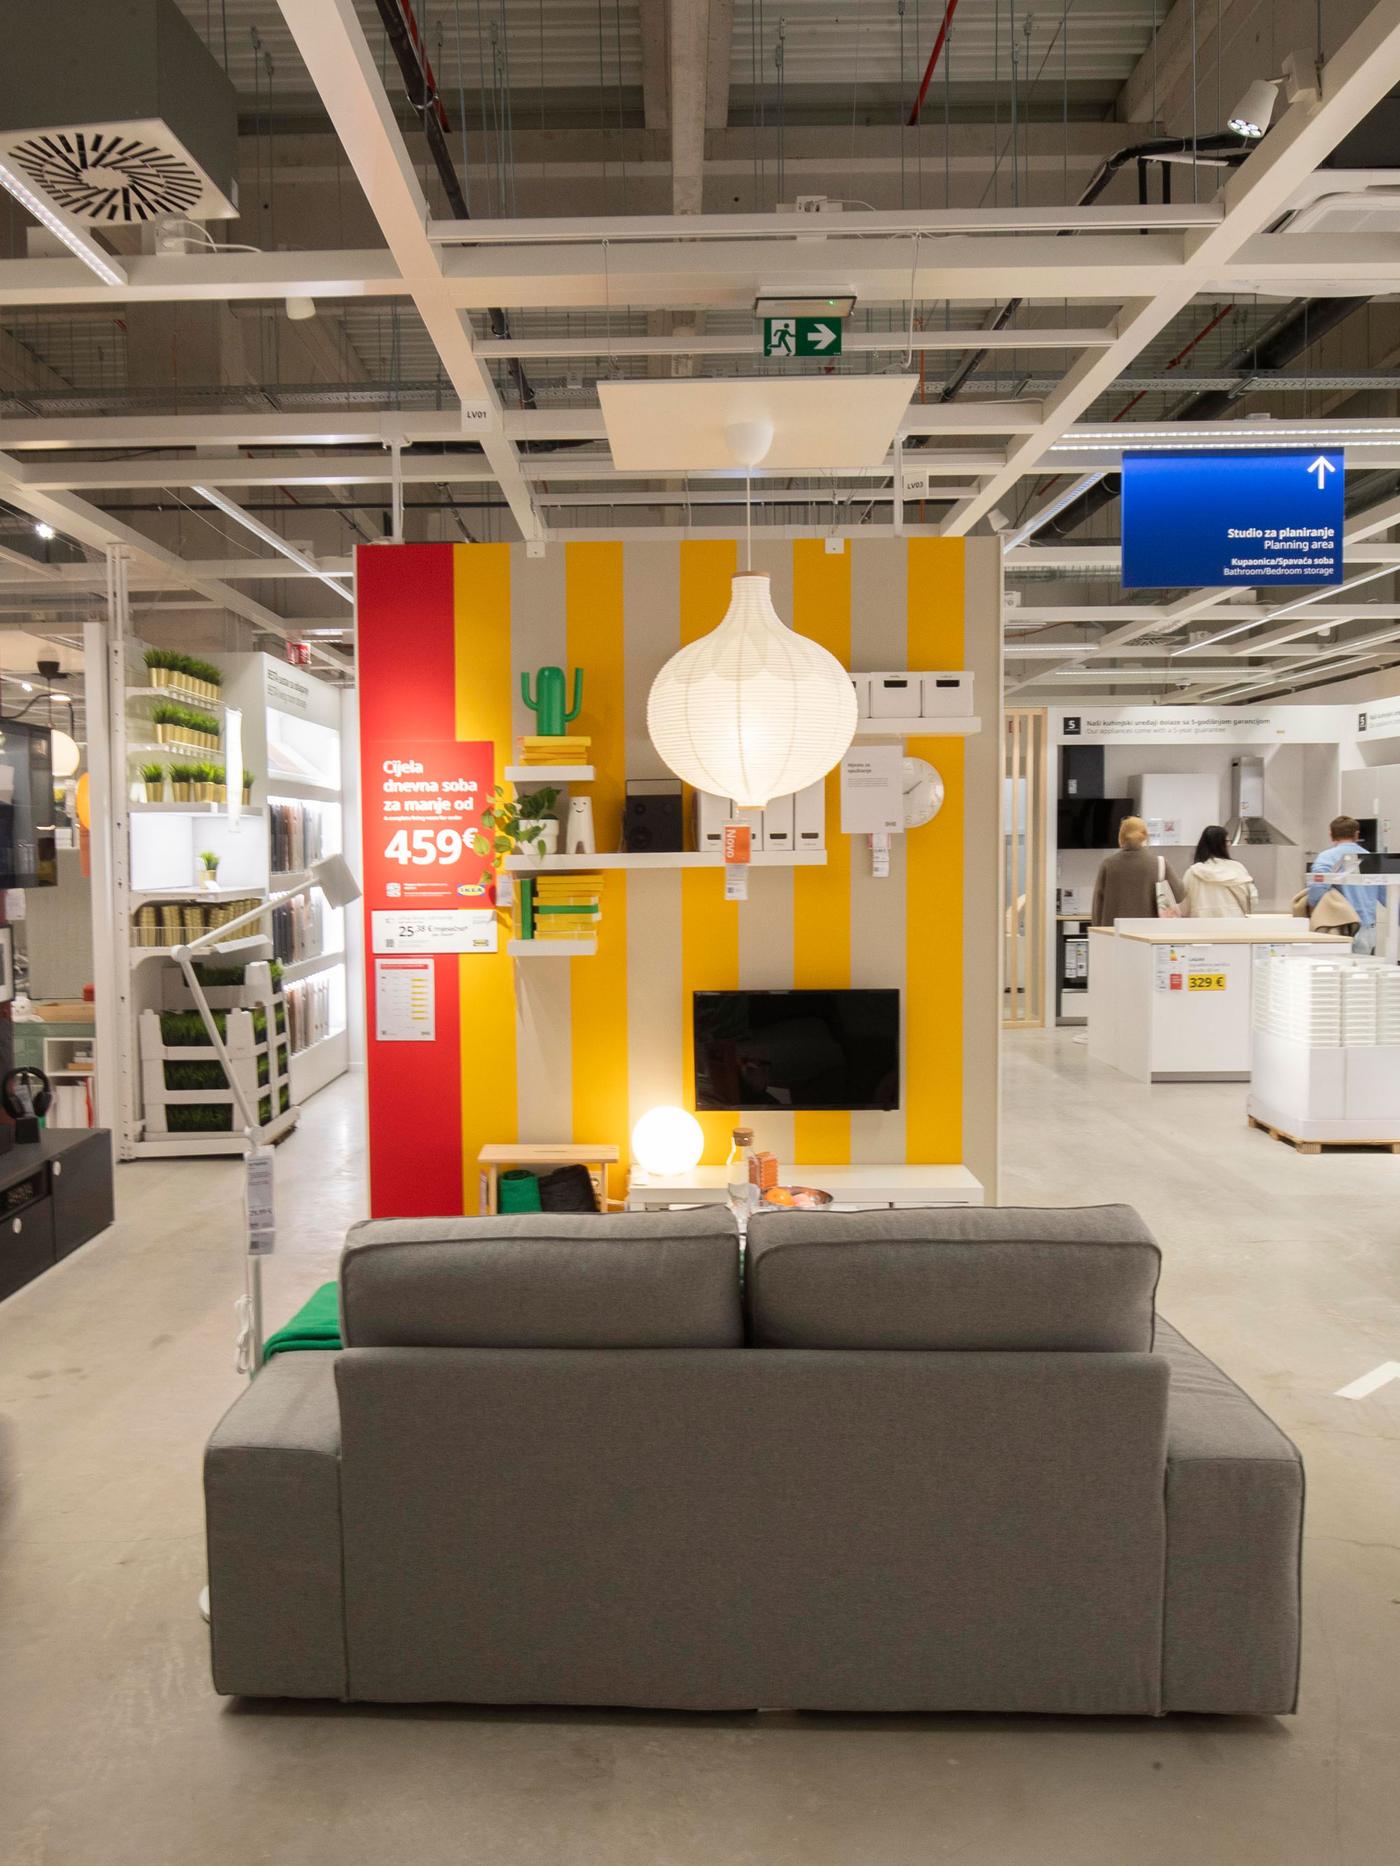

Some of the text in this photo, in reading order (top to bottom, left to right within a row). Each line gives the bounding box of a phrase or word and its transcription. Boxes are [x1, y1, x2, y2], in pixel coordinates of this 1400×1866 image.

[467, 410, 487, 418] LV01
[1227, 527, 1335, 539] Studio za planiranje
[1264, 540, 1335, 552] Planning area
[1313, 557, 1335, 565] soba
[1223, 567, 1335, 576] Bathroom/Bedroom storage
[1068, 720, 1076, 729] 5
[383, 760, 424, 777] Cijela
[383, 778, 478, 792] dnevna soba
[383, 797, 474, 814] za manje od
[727, 829, 737, 858] Novo
[1189, 977, 1213, 988] 329
[1216, 976, 1224, 987] €
